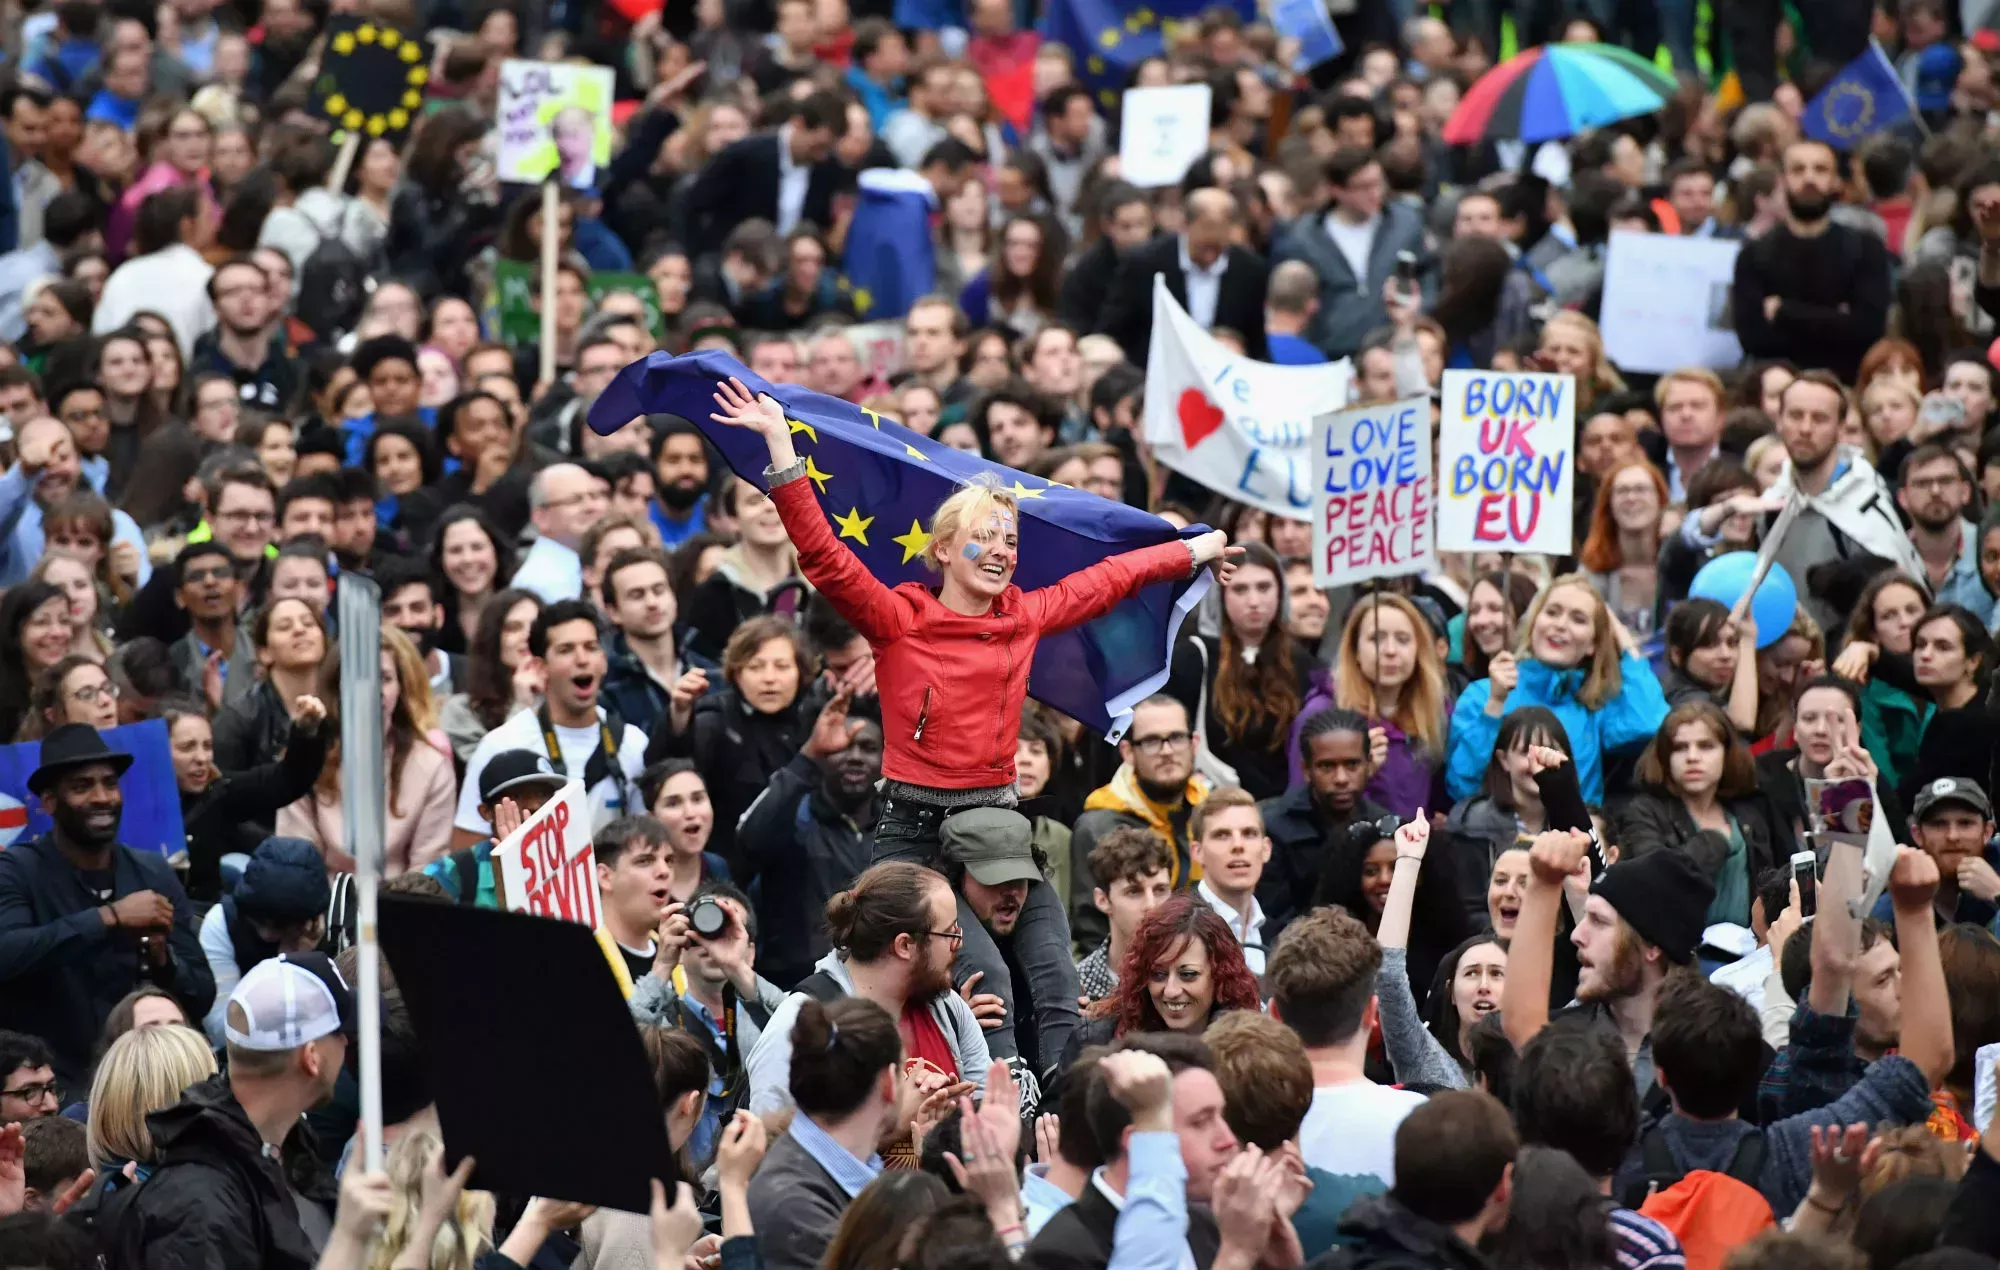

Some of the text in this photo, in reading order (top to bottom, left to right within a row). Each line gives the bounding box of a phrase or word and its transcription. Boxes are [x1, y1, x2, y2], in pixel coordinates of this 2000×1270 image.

[1462, 377, 1564, 421] BORN
[1326, 408, 1416, 458] LOVE
[1479, 416, 1536, 457] UK
[1324, 448, 1417, 493] LOVE
[1450, 449, 1565, 499] BORN
[1325, 476, 1428, 534] PEACE
[1473, 491, 1541, 543] EU
[1326, 517, 1425, 575] PEACE
[520, 800, 569, 895] STOP
